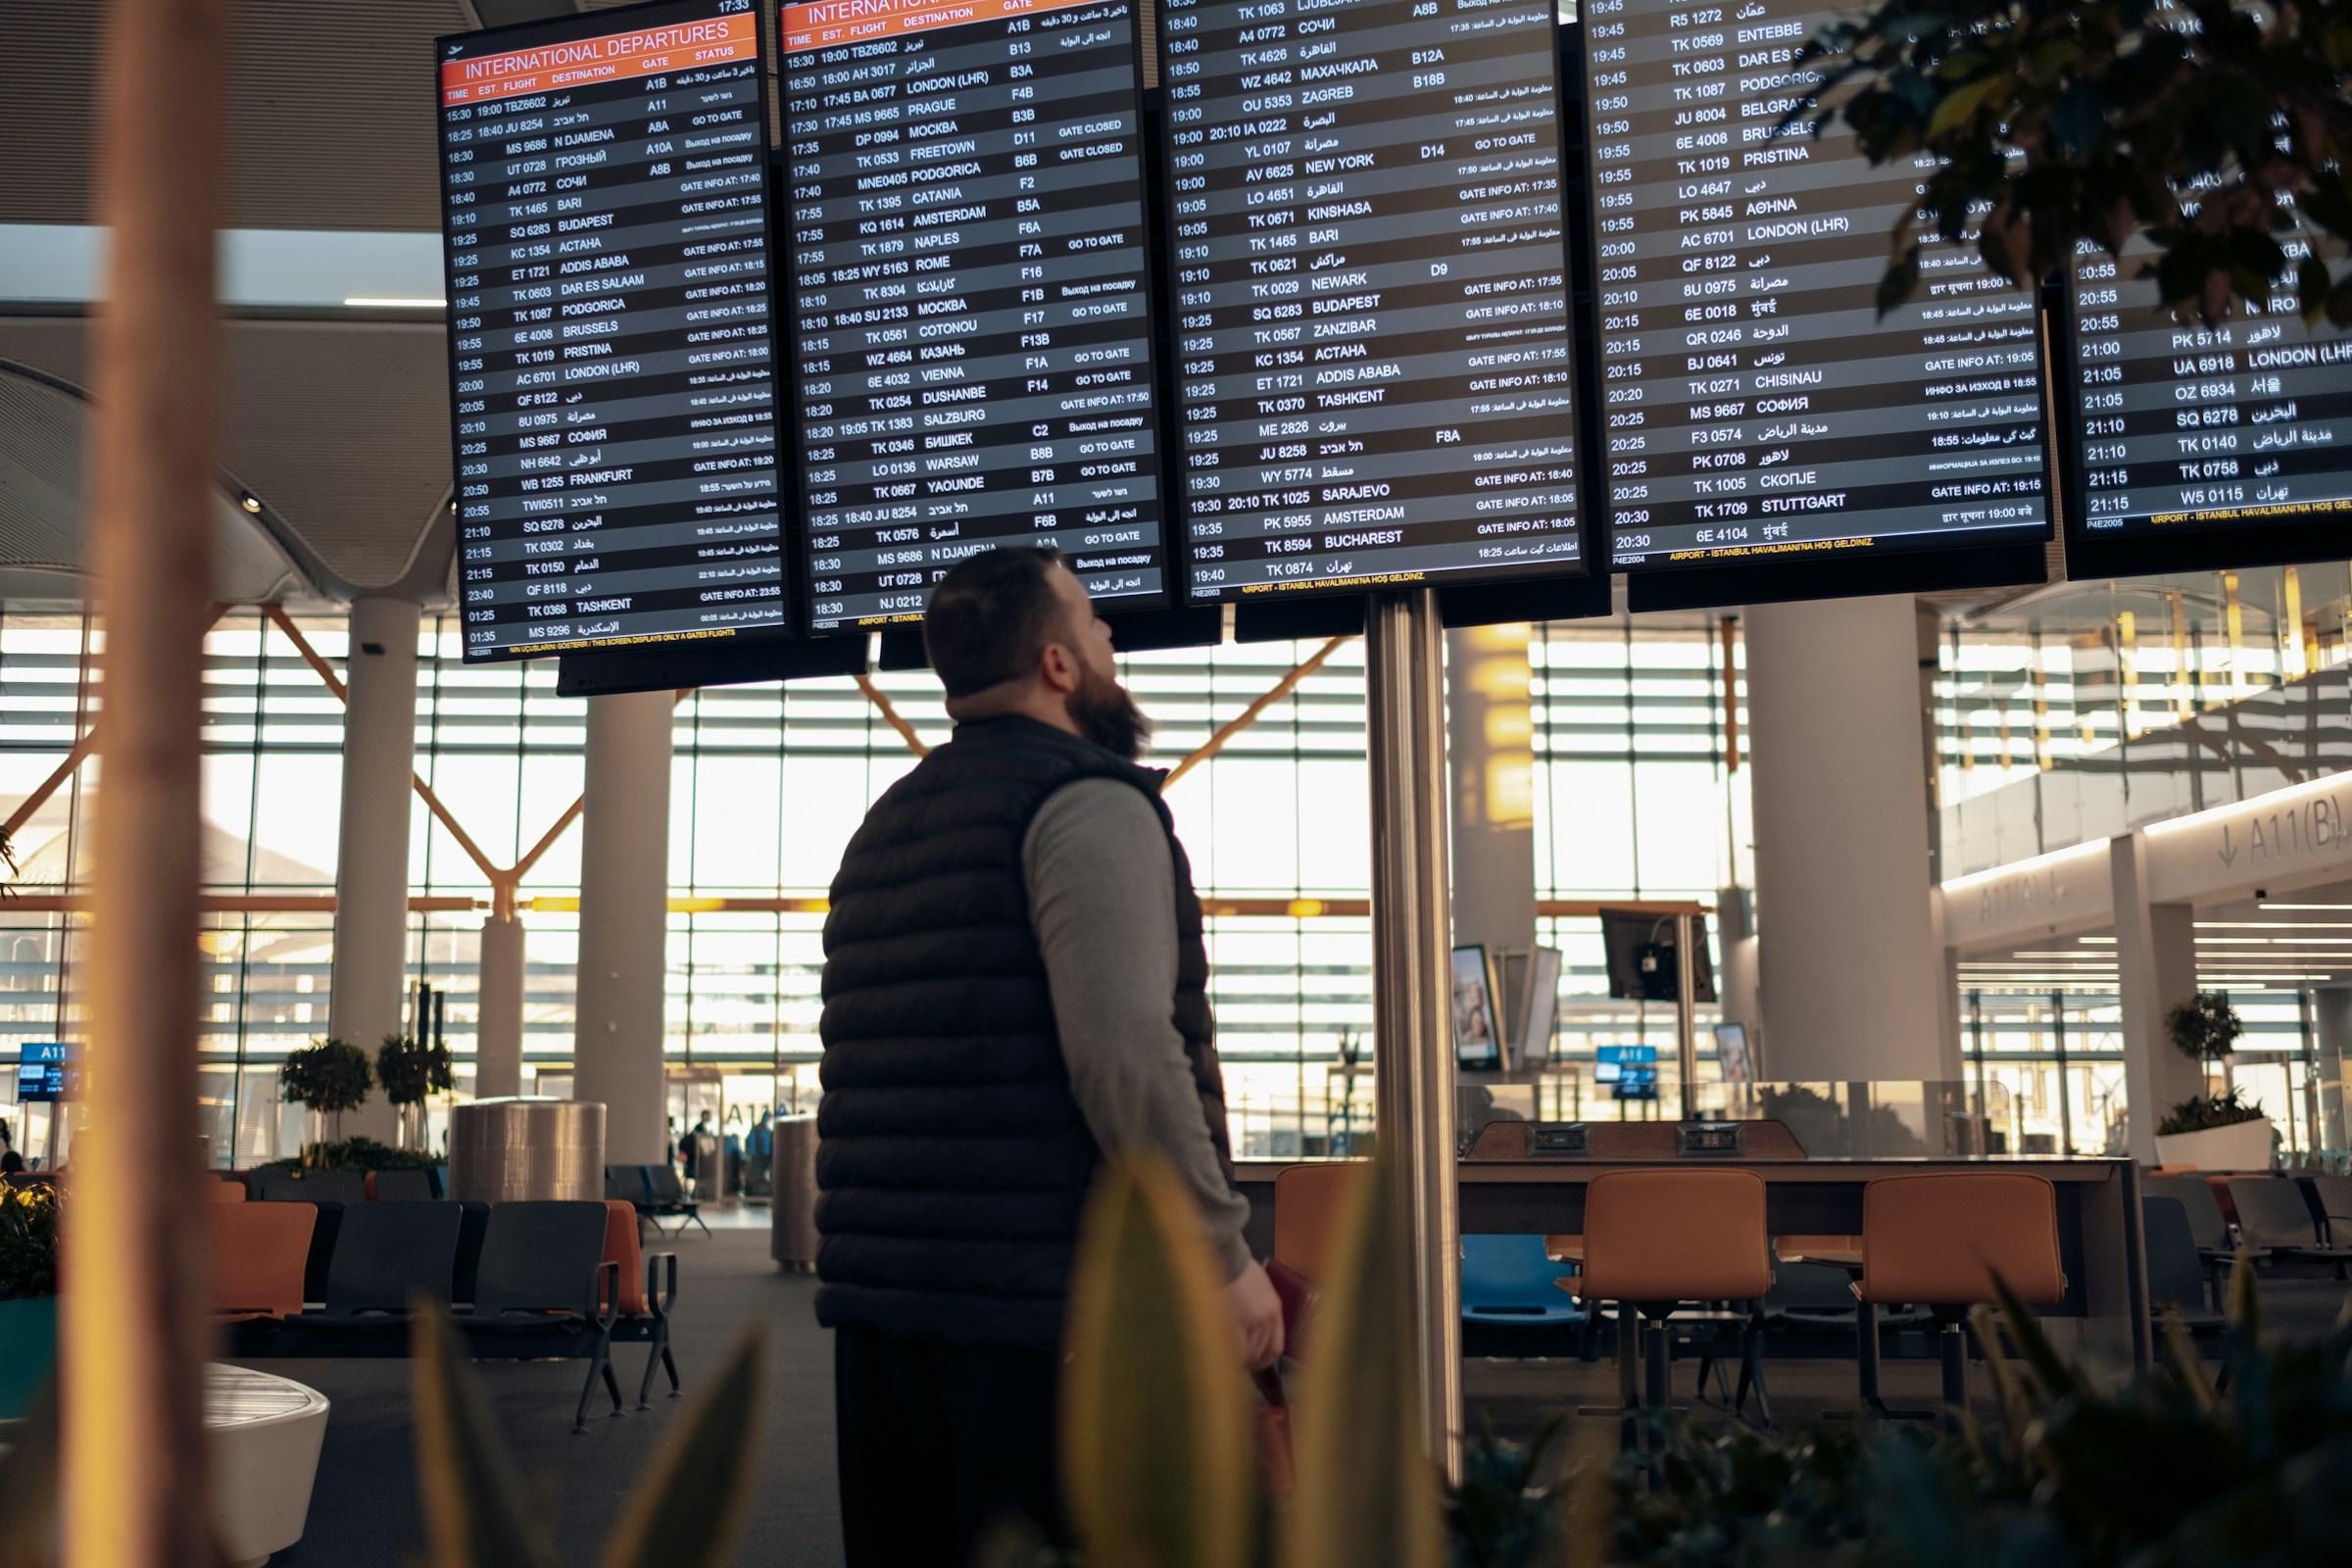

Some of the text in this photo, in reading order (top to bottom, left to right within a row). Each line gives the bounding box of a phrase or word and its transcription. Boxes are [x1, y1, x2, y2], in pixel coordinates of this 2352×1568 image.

[718, 0, 750, 13] 17:33
[787, 0, 1032, 45] TIME EST. FLIGHT DESTINATION GATE
[466, 22, 728, 78] INTERNATIONAL DEPARTURES
[1592, 22, 1802, 62] 19:45 TK 0569 ENTEBBE
[447, 45, 734, 99] TIME EST. FLIGHT DESTINATION GATE STATUS
[790, 64, 1033, 112] 17:10 17:45 BA 0677 LONDON (LHR) B3A
[1170, 49, 1444, 99] 18:55 WZ 4642 МАХАЧКАЛА B12A
[449, 110, 742, 162] 18:30 MS 9686 N DJAMENA A8A GO TO GATE
[450, 171, 474, 183] 18:30
[507, 163, 521, 174] UT
[522, 160, 546, 172] 0728
[556, 149, 606, 168] ГРОЗНЫЙ
[646, 141, 673, 154] A10A
[685, 138, 710, 148] Выход
[721, 132, 752, 142] посадку
[794, 142, 1122, 199] 17:40 MNE0405 PODGORICA B6B GATE CLOSED
[1175, 133, 1536, 190] 19:00 AV 6625 NEW YORK D14 GO TO GATE
[799, 233, 1123, 286] 18:05 18:25 WY 5163 ROME F7A GO TO GATE
[1601, 217, 1848, 256] 20:00 AC 6701 LONDON (LHR)
[456, 259, 764, 308] 19:45 TK 0603 DAR ES SALAAM GATE INFO AT: 18:15
[1183, 299, 1563, 351] 19:25 TK 0567 ZANZIBAR GATE INFO AT: 18:10
[803, 333, 1050, 372] 18:15 WZ 4664 КАЗАНЬ F13B
[2083, 367, 2121, 382] 21:05
[2174, 360, 2196, 374] UA
[2198, 356, 2233, 371] 6918
[2248, 347, 2316, 368] LONDON
[1609, 376, 2036, 426] 20:25 MS 9667 СОФИЯ ИНФО ЗА ИЗХОД В 18:55
[2084, 377, 2280, 408] 21:05 OZ 6934 서울
[461, 421, 485, 433] 20:10
[517, 416, 532, 427] 8U
[533, 413, 558, 425] 0975
[1614, 479, 2040, 524] 20:30 TK 1709 STUTTGART GATE INFO AT: 19:15
[2090, 485, 2287, 512] 21:15 W5 0115 تهران
[2250, 794, 2342, 863] A11(B)
[41, 1047, 66, 1059] A11
[1618, 1049, 1642, 1061] A11
